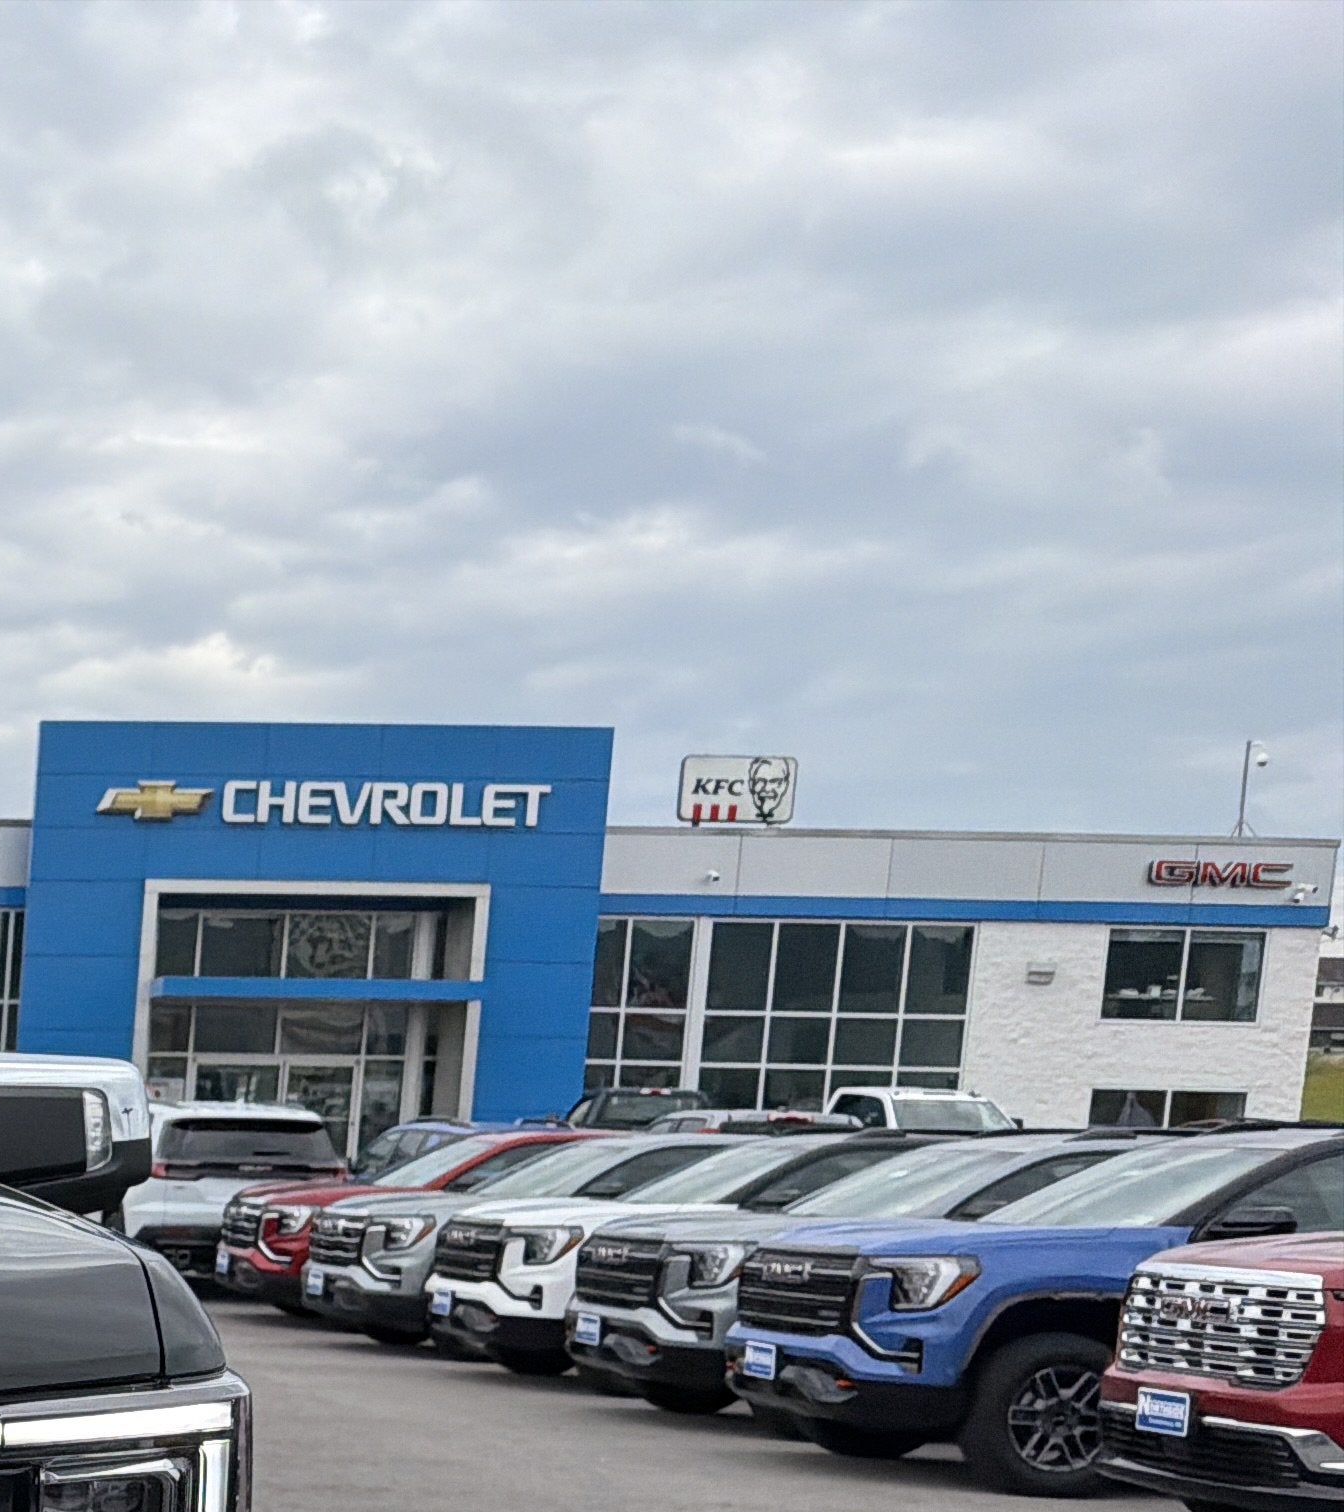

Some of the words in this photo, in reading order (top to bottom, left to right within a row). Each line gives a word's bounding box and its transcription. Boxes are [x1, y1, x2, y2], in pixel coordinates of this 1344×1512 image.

[691, 778, 744, 797] KFC
[222, 780, 552, 827] CHEVROLET
[1148, 860, 1294, 890] GMC
